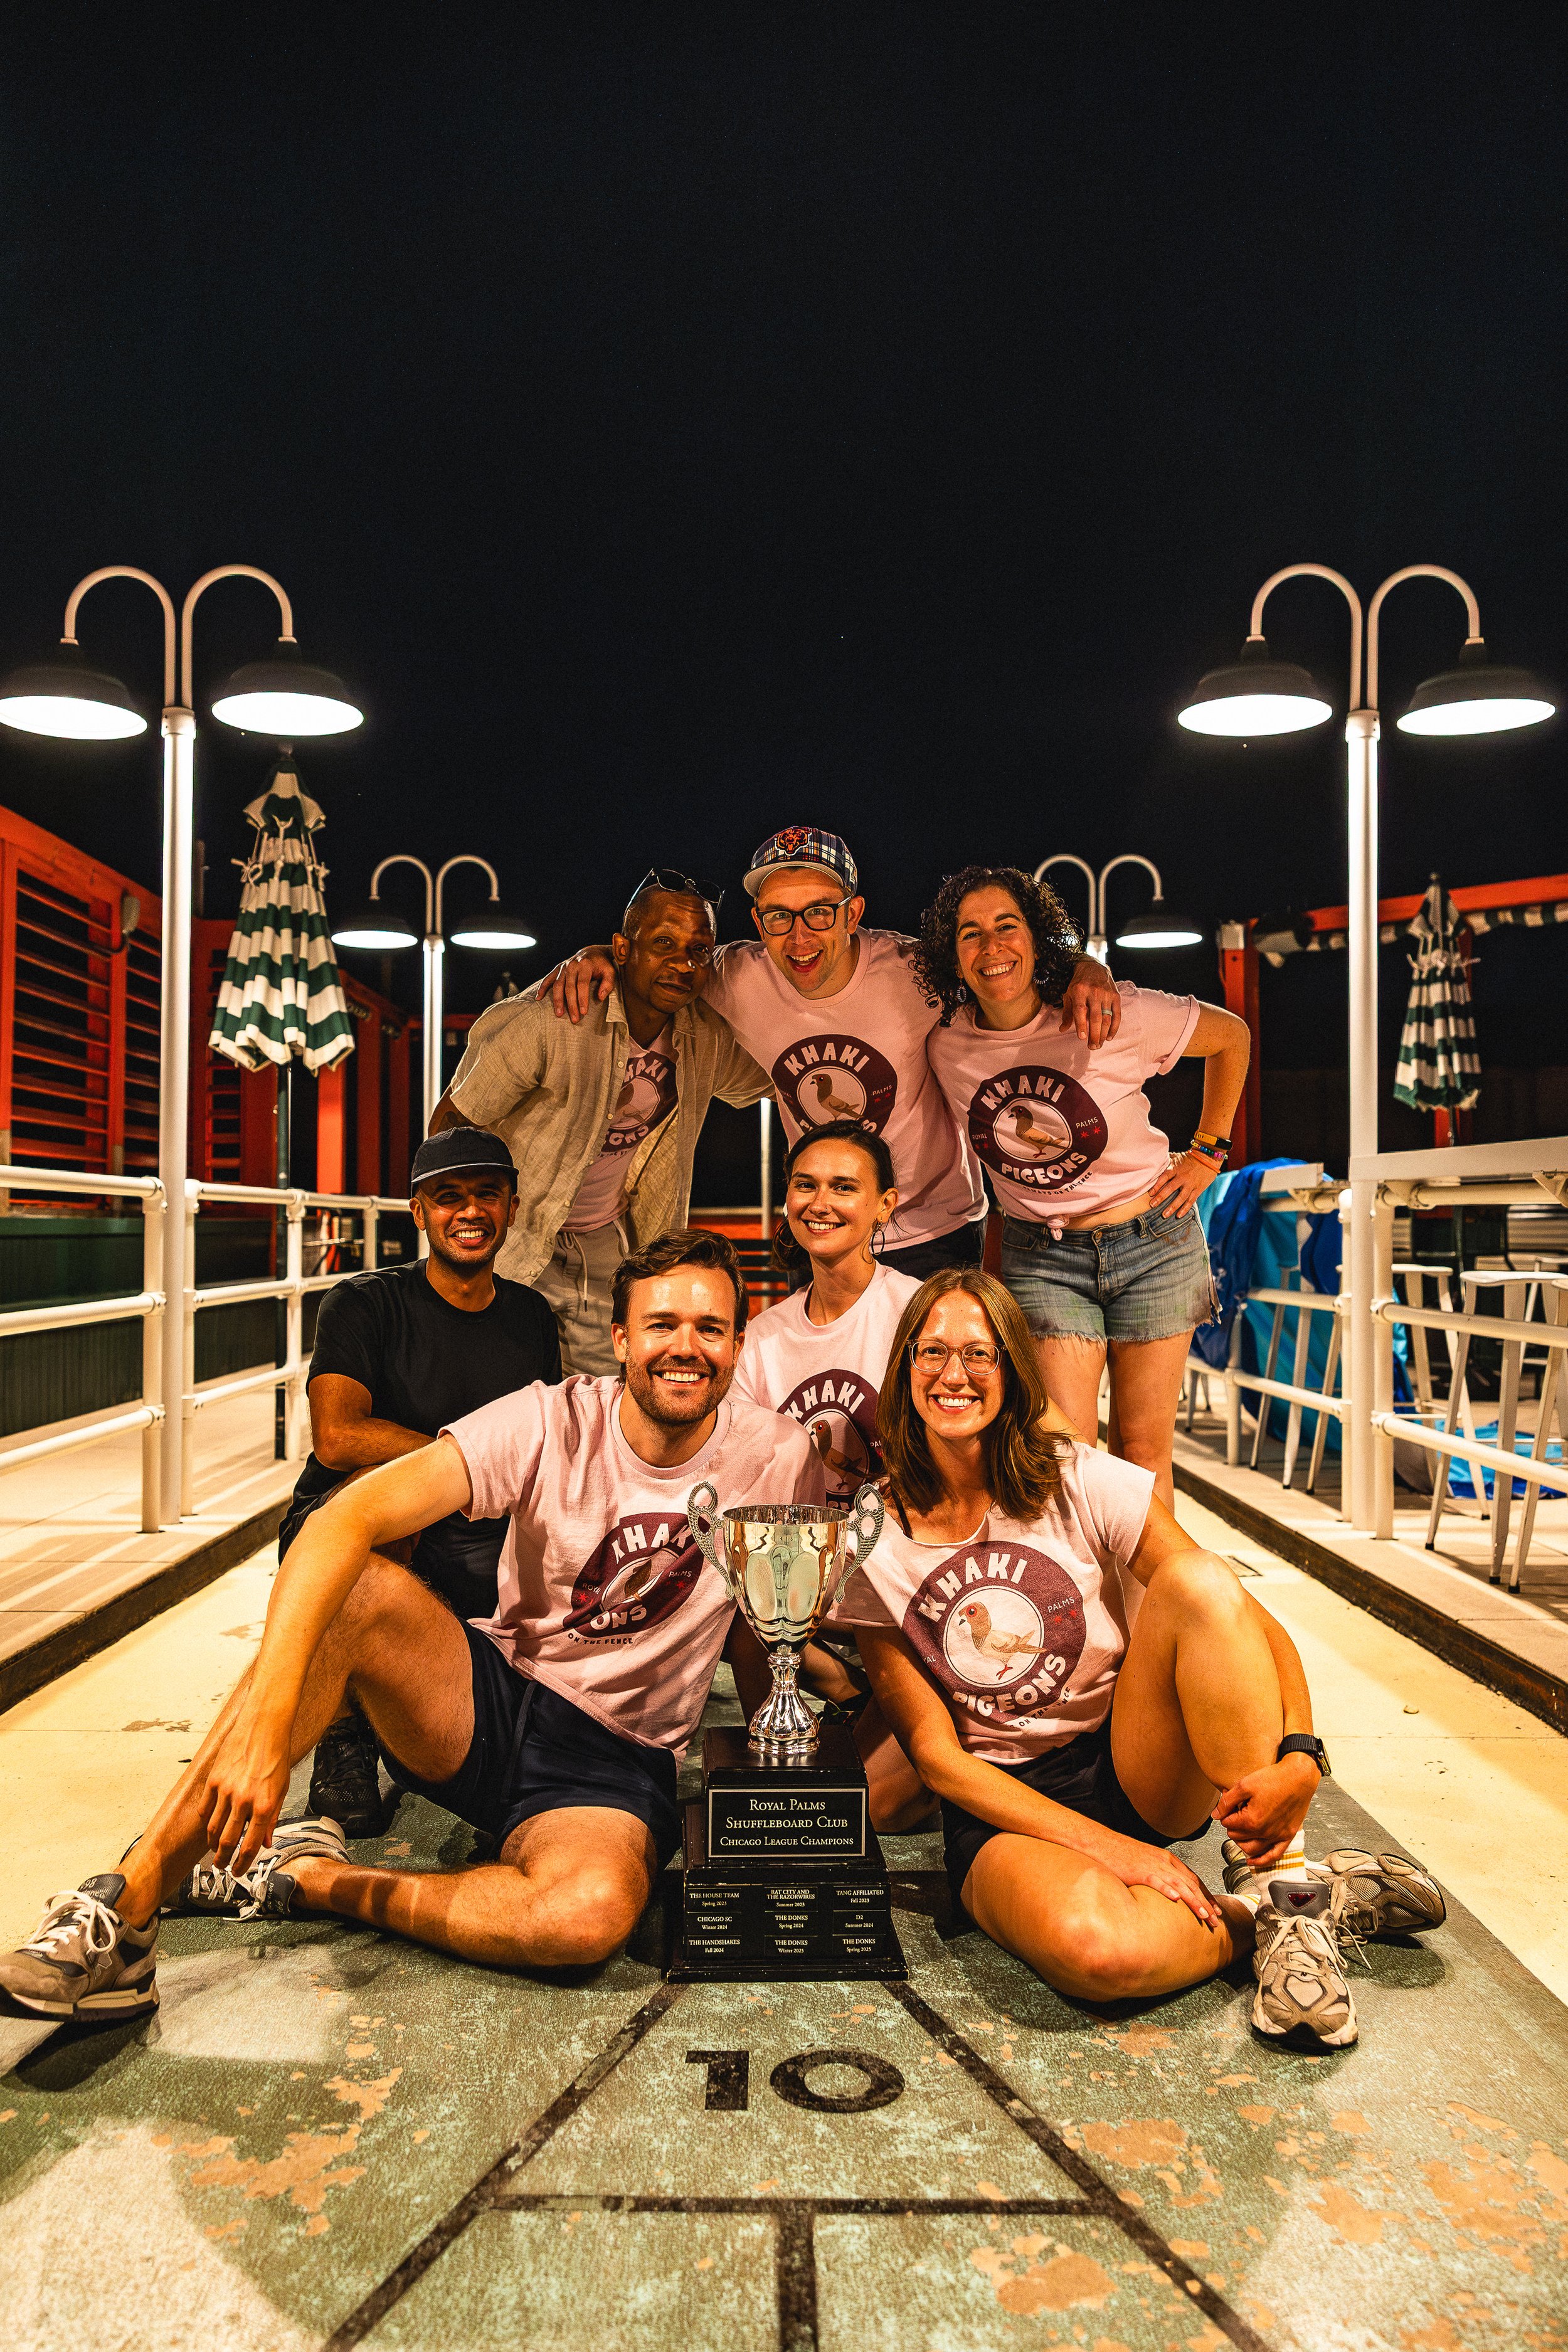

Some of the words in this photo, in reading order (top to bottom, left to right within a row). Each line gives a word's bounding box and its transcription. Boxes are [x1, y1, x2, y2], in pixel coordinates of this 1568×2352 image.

[784, 1042, 870, 1076] KHAKI
[624, 1057, 669, 1083] HAKI
[872, 1084, 893, 1096] PALMS
[980, 1074, 1066, 1111] KHAKI
[1076, 1116, 1099, 1129] PALMS
[1001, 1152, 1088, 1185] PIGEONS
[784, 1379, 866, 1420] KHAKI
[612, 1523, 691, 1565] KHAK
[669, 1570, 692, 1578] PALMS
[918, 1552, 1028, 1623] KHAKI
[1047, 1596, 1076, 1613] PALMS
[568, 1633, 581, 1643] ON
[952, 1653, 1066, 1717] PIGEONS
[1019, 1719, 1031, 1727] ON
[750, 1799, 787, 1811] ROYAL
[790, 1799, 826, 1810] PALMS
[726, 1816, 813, 1828] SHUFFLEBOARD
[817, 1816, 849, 1828] CLUB
[720, 1836, 761, 1846] CHICAGO
[764, 1836, 798, 1845] LEAGUE
[800, 1836, 854, 1845] CHAMPIONS
[685, 2050, 906, 2114] 10
